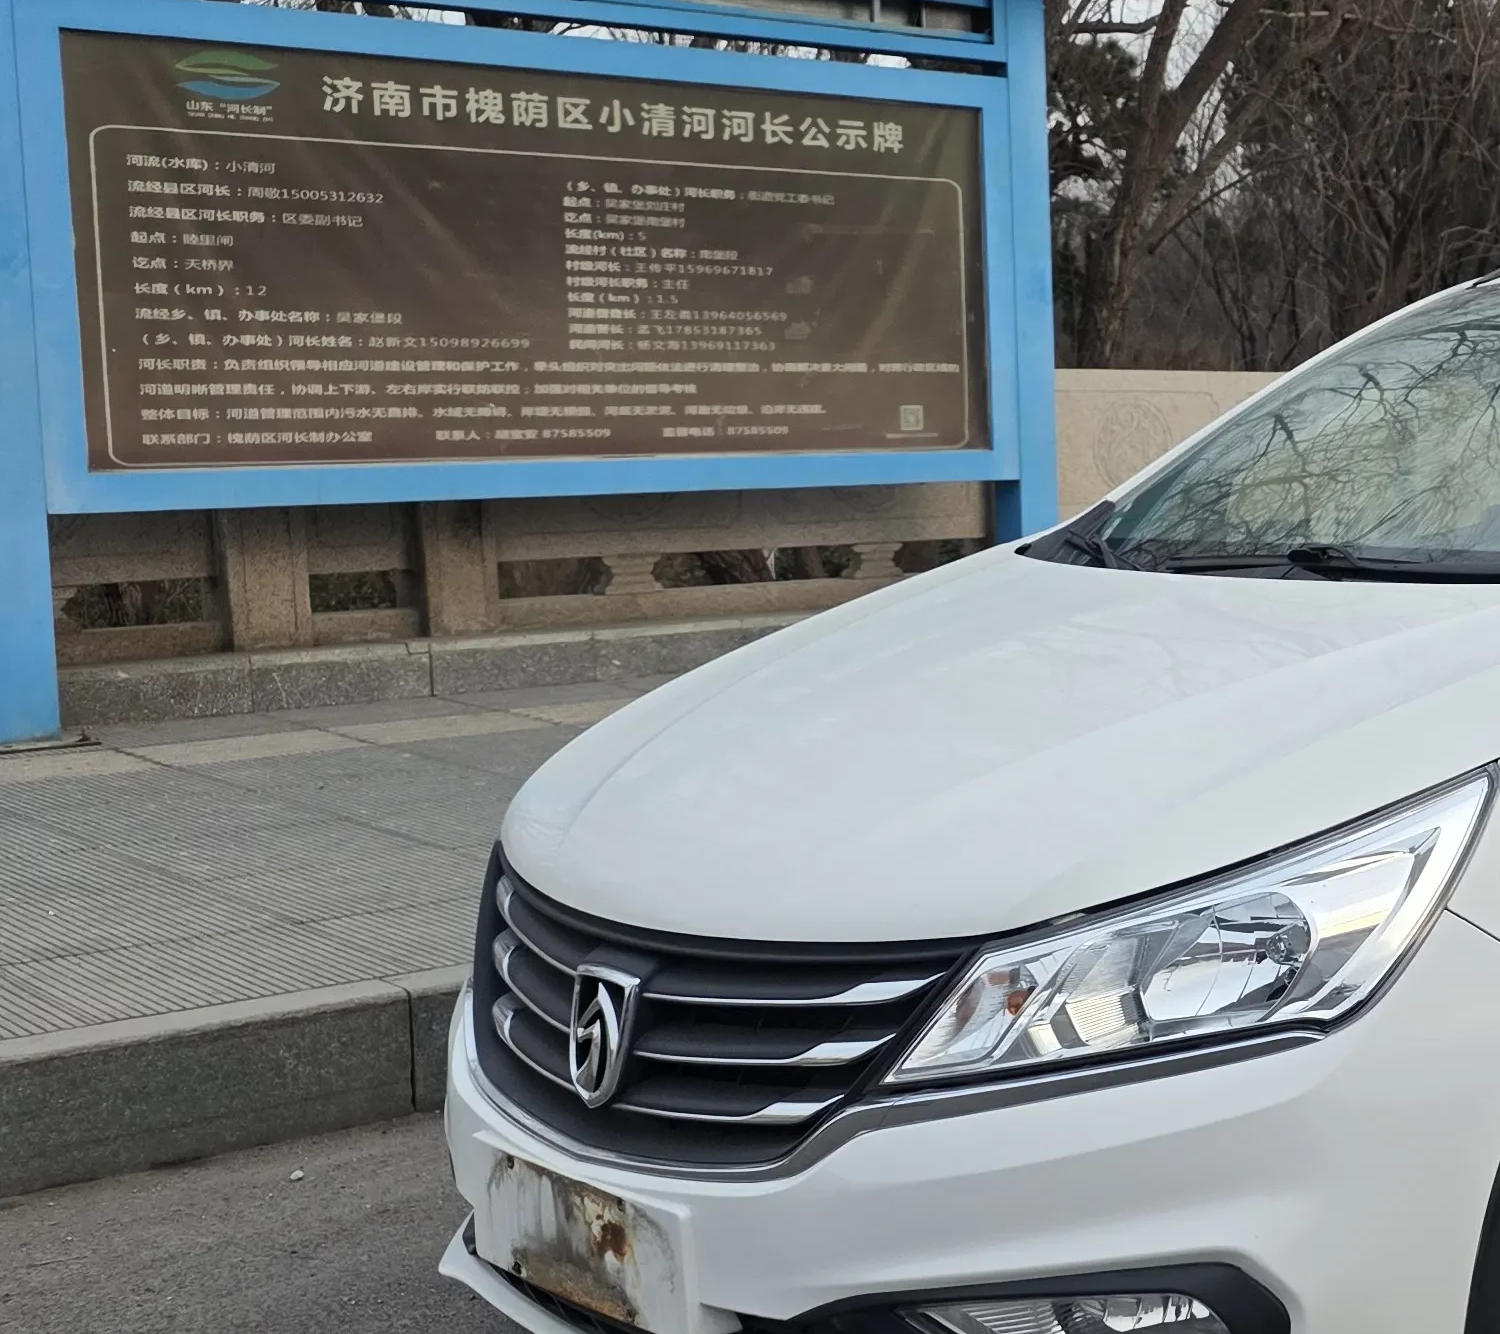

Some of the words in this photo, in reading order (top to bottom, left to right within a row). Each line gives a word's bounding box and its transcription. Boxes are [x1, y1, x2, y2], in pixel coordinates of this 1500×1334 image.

[321, 75, 905, 154] 济南市槐荫区小清河河长公示牌
